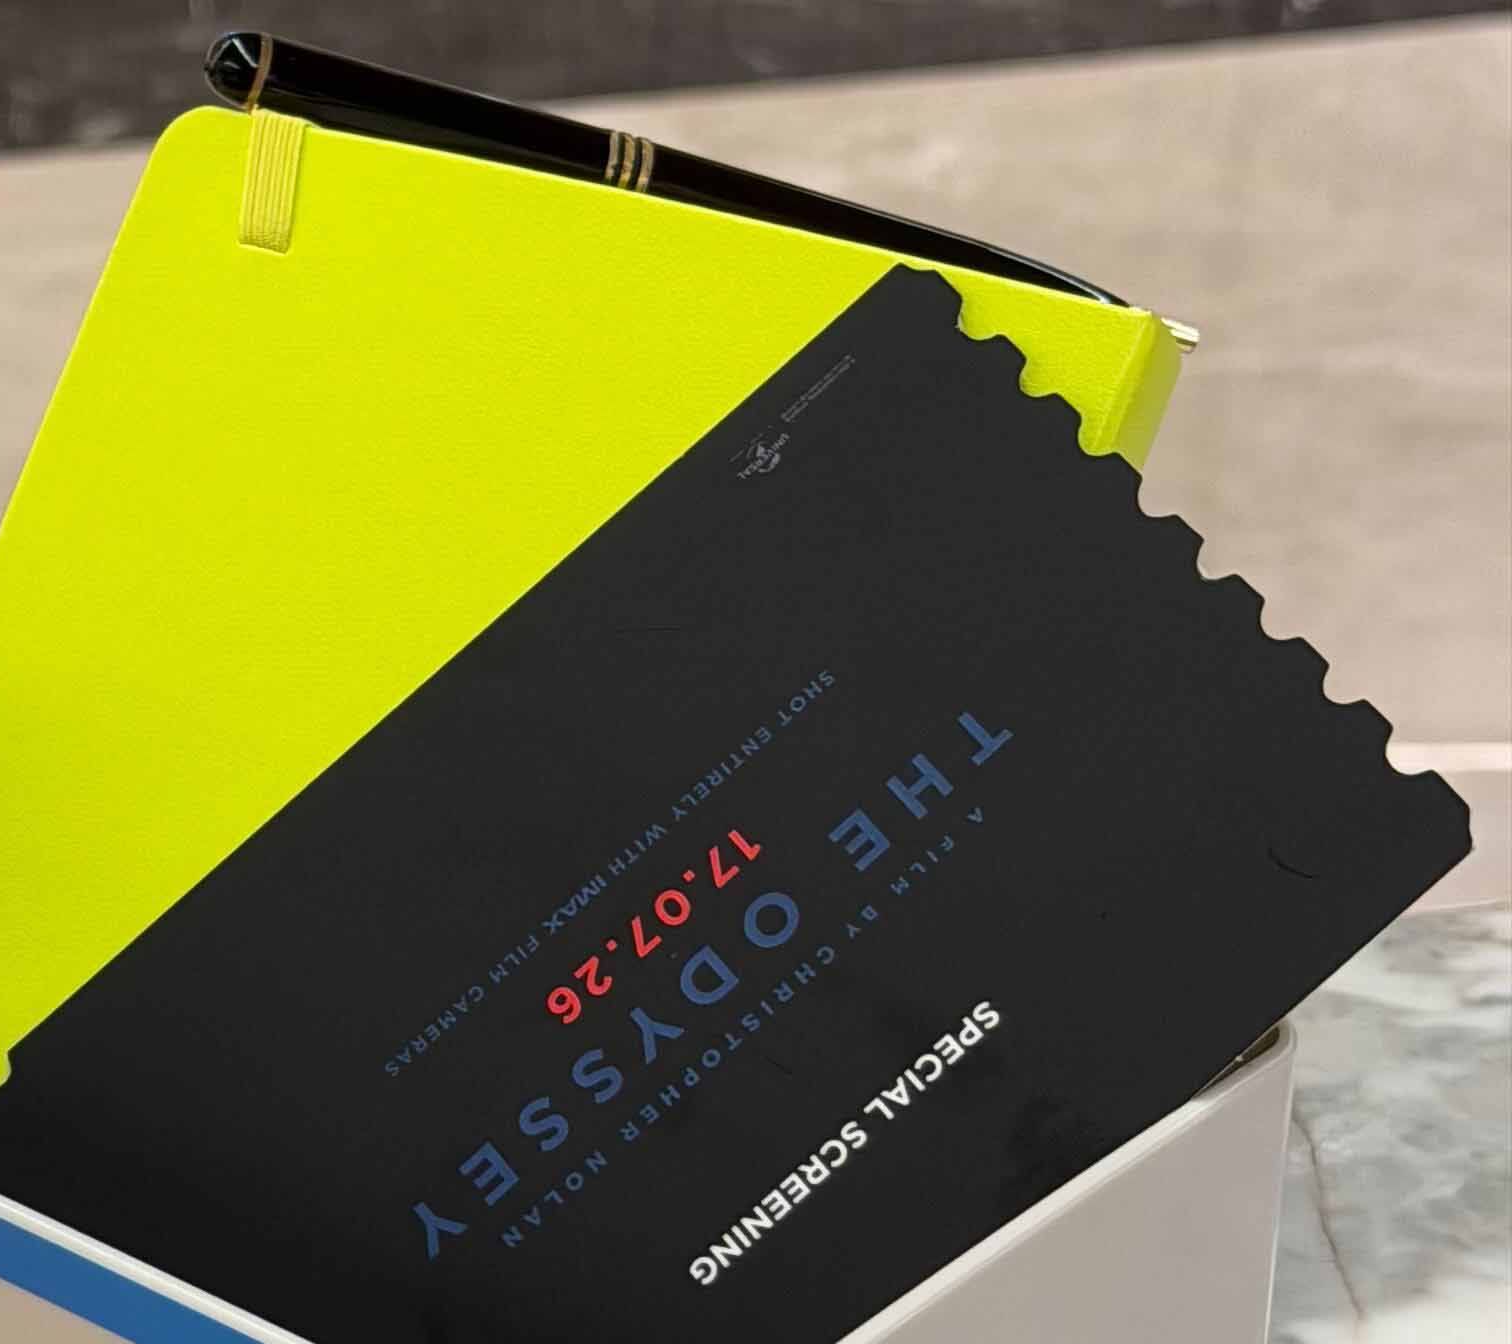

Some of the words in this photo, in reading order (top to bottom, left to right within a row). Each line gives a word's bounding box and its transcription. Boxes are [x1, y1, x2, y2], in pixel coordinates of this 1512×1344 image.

[777, 670, 835, 727] SHOT
[671, 726, 773, 822] ENTIRELY
[828, 712, 1013, 872] THE
[966, 807, 984, 824] A
[607, 823, 668, 876] WITH
[889, 835, 955, 896] FILM
[541, 874, 608, 935] IMAX
[544, 829, 762, 1024] 17.07.26
[846, 904, 880, 939] BY
[488, 935, 540, 984] FILM
[384, 985, 485, 1077] CAMERAS
[413, 892, 800, 1260] ODYSSEY
[619, 945, 835, 1142] CHRISTOPHER
[863, 1001, 1002, 1120] SPECIAL
[501, 1151, 608, 1248] NOLAN
[689, 1121, 868, 1286] SCREENING
